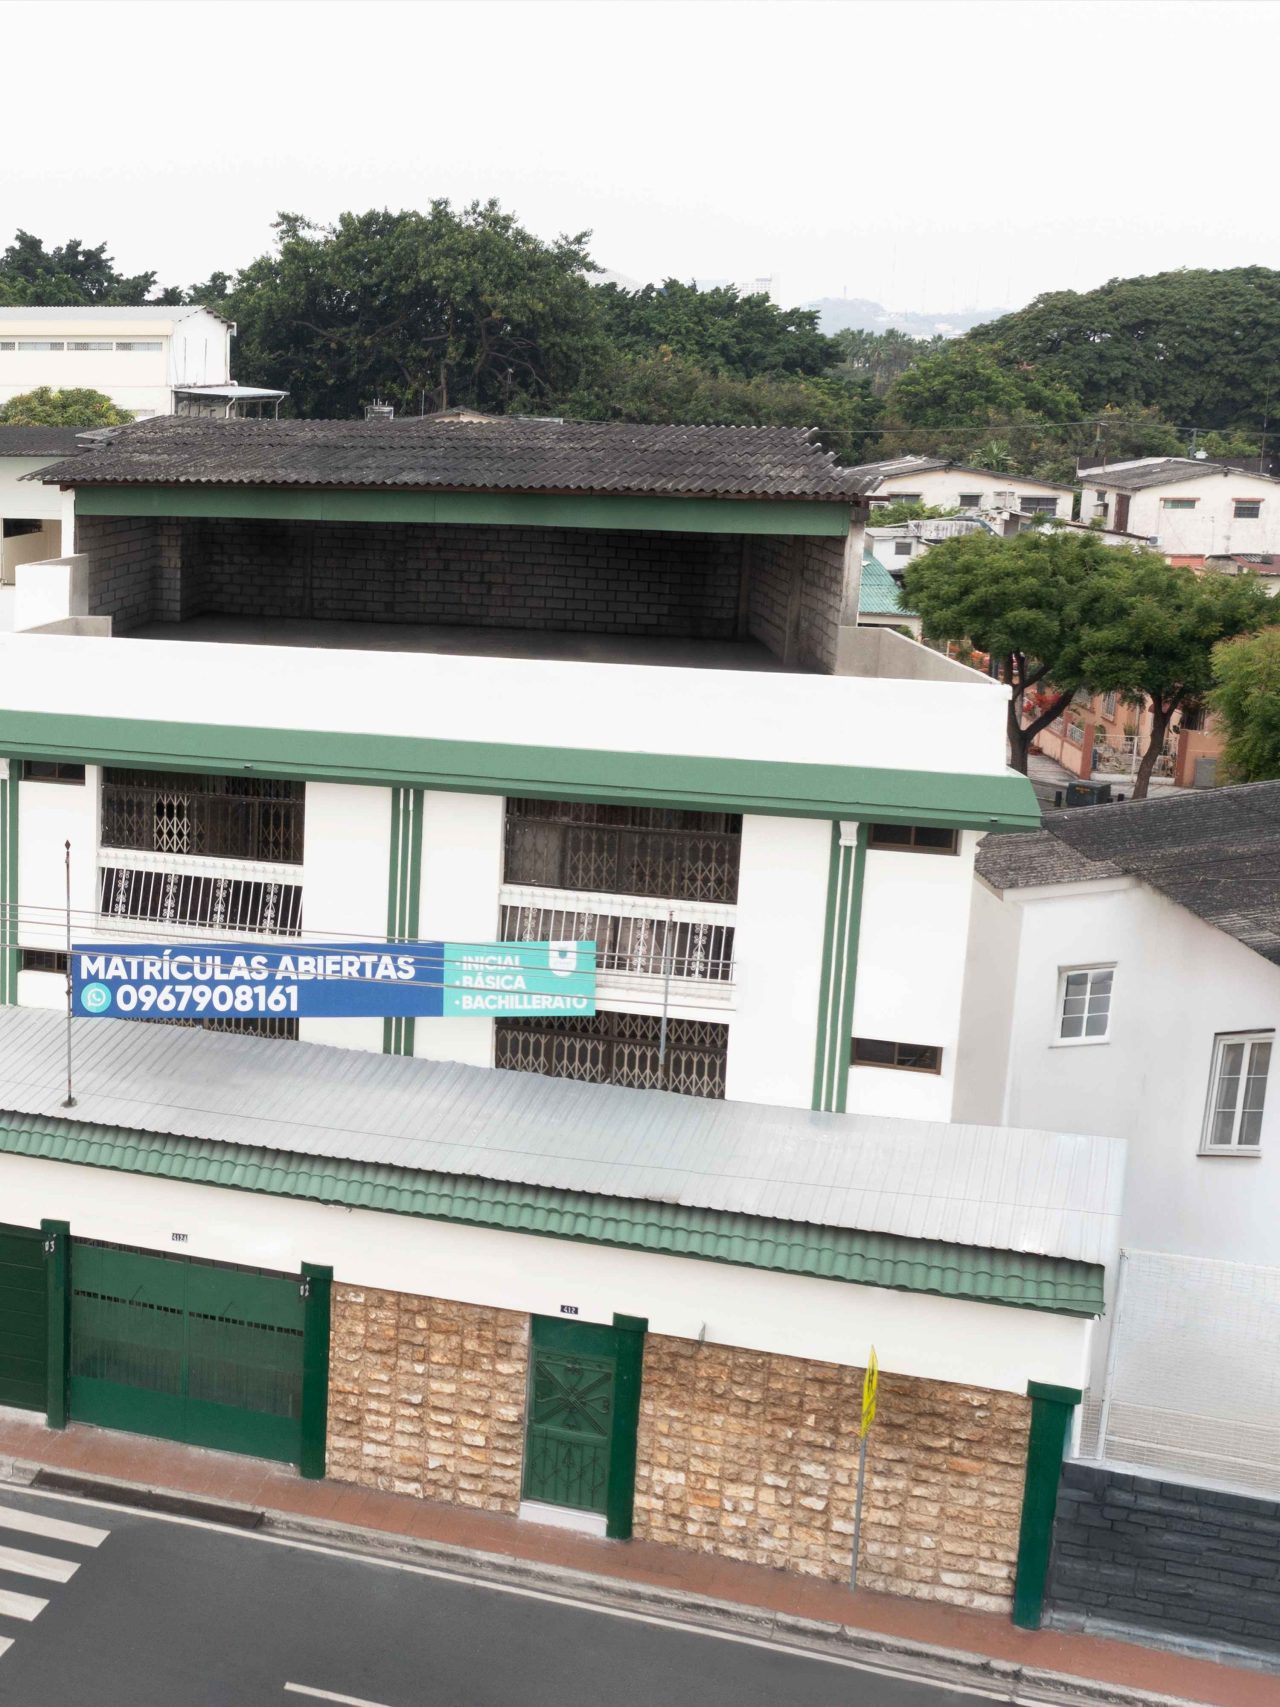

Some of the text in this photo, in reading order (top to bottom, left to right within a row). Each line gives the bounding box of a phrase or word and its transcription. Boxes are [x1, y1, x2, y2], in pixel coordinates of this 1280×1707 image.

[80, 949, 416, 981] MATRÍCULAS ABIERTAS
[462, 955, 524, 971] INICIAL
[116, 984, 299, 1012] 0967908161
[462, 994, 588, 1010] BACHILLERATO
